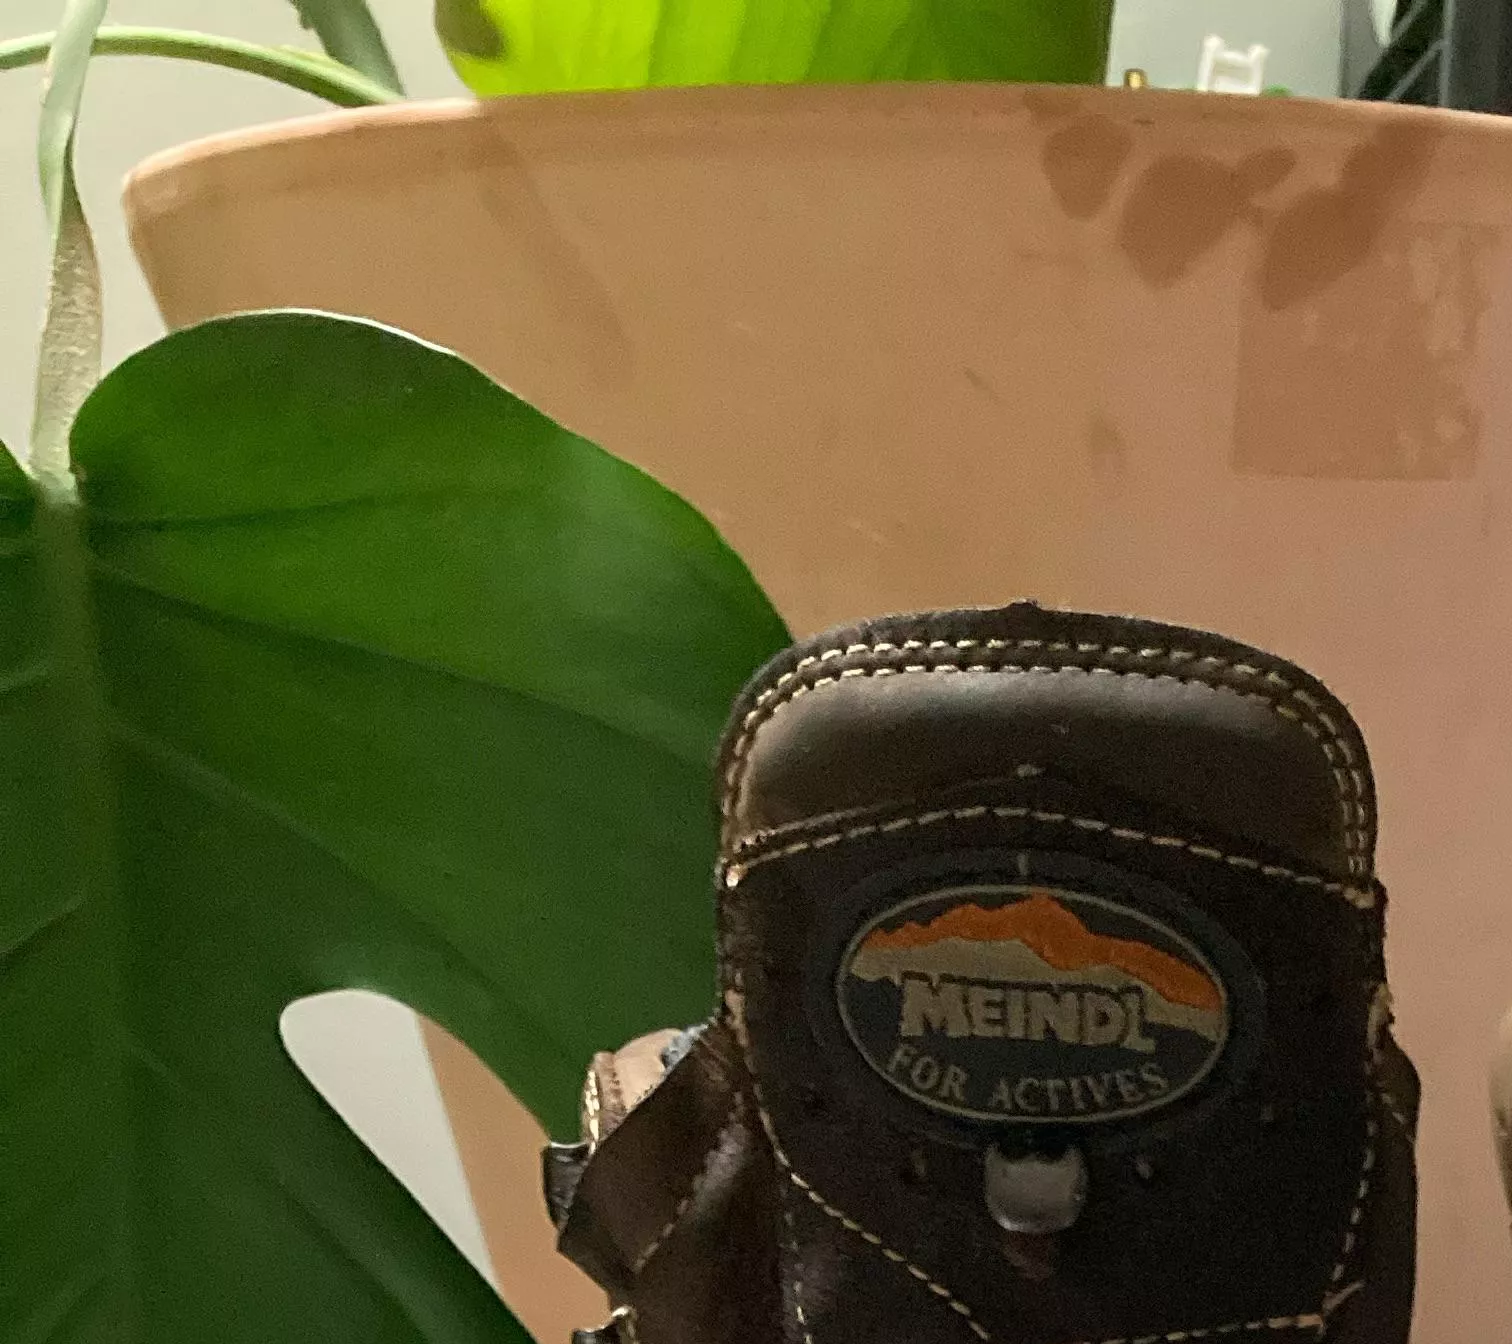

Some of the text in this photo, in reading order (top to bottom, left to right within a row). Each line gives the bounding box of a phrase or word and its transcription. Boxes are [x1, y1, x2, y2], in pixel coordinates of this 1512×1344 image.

[899, 974, 1156, 1054] MEINDL
[887, 1043, 1170, 1112] FOR ACTIVES
